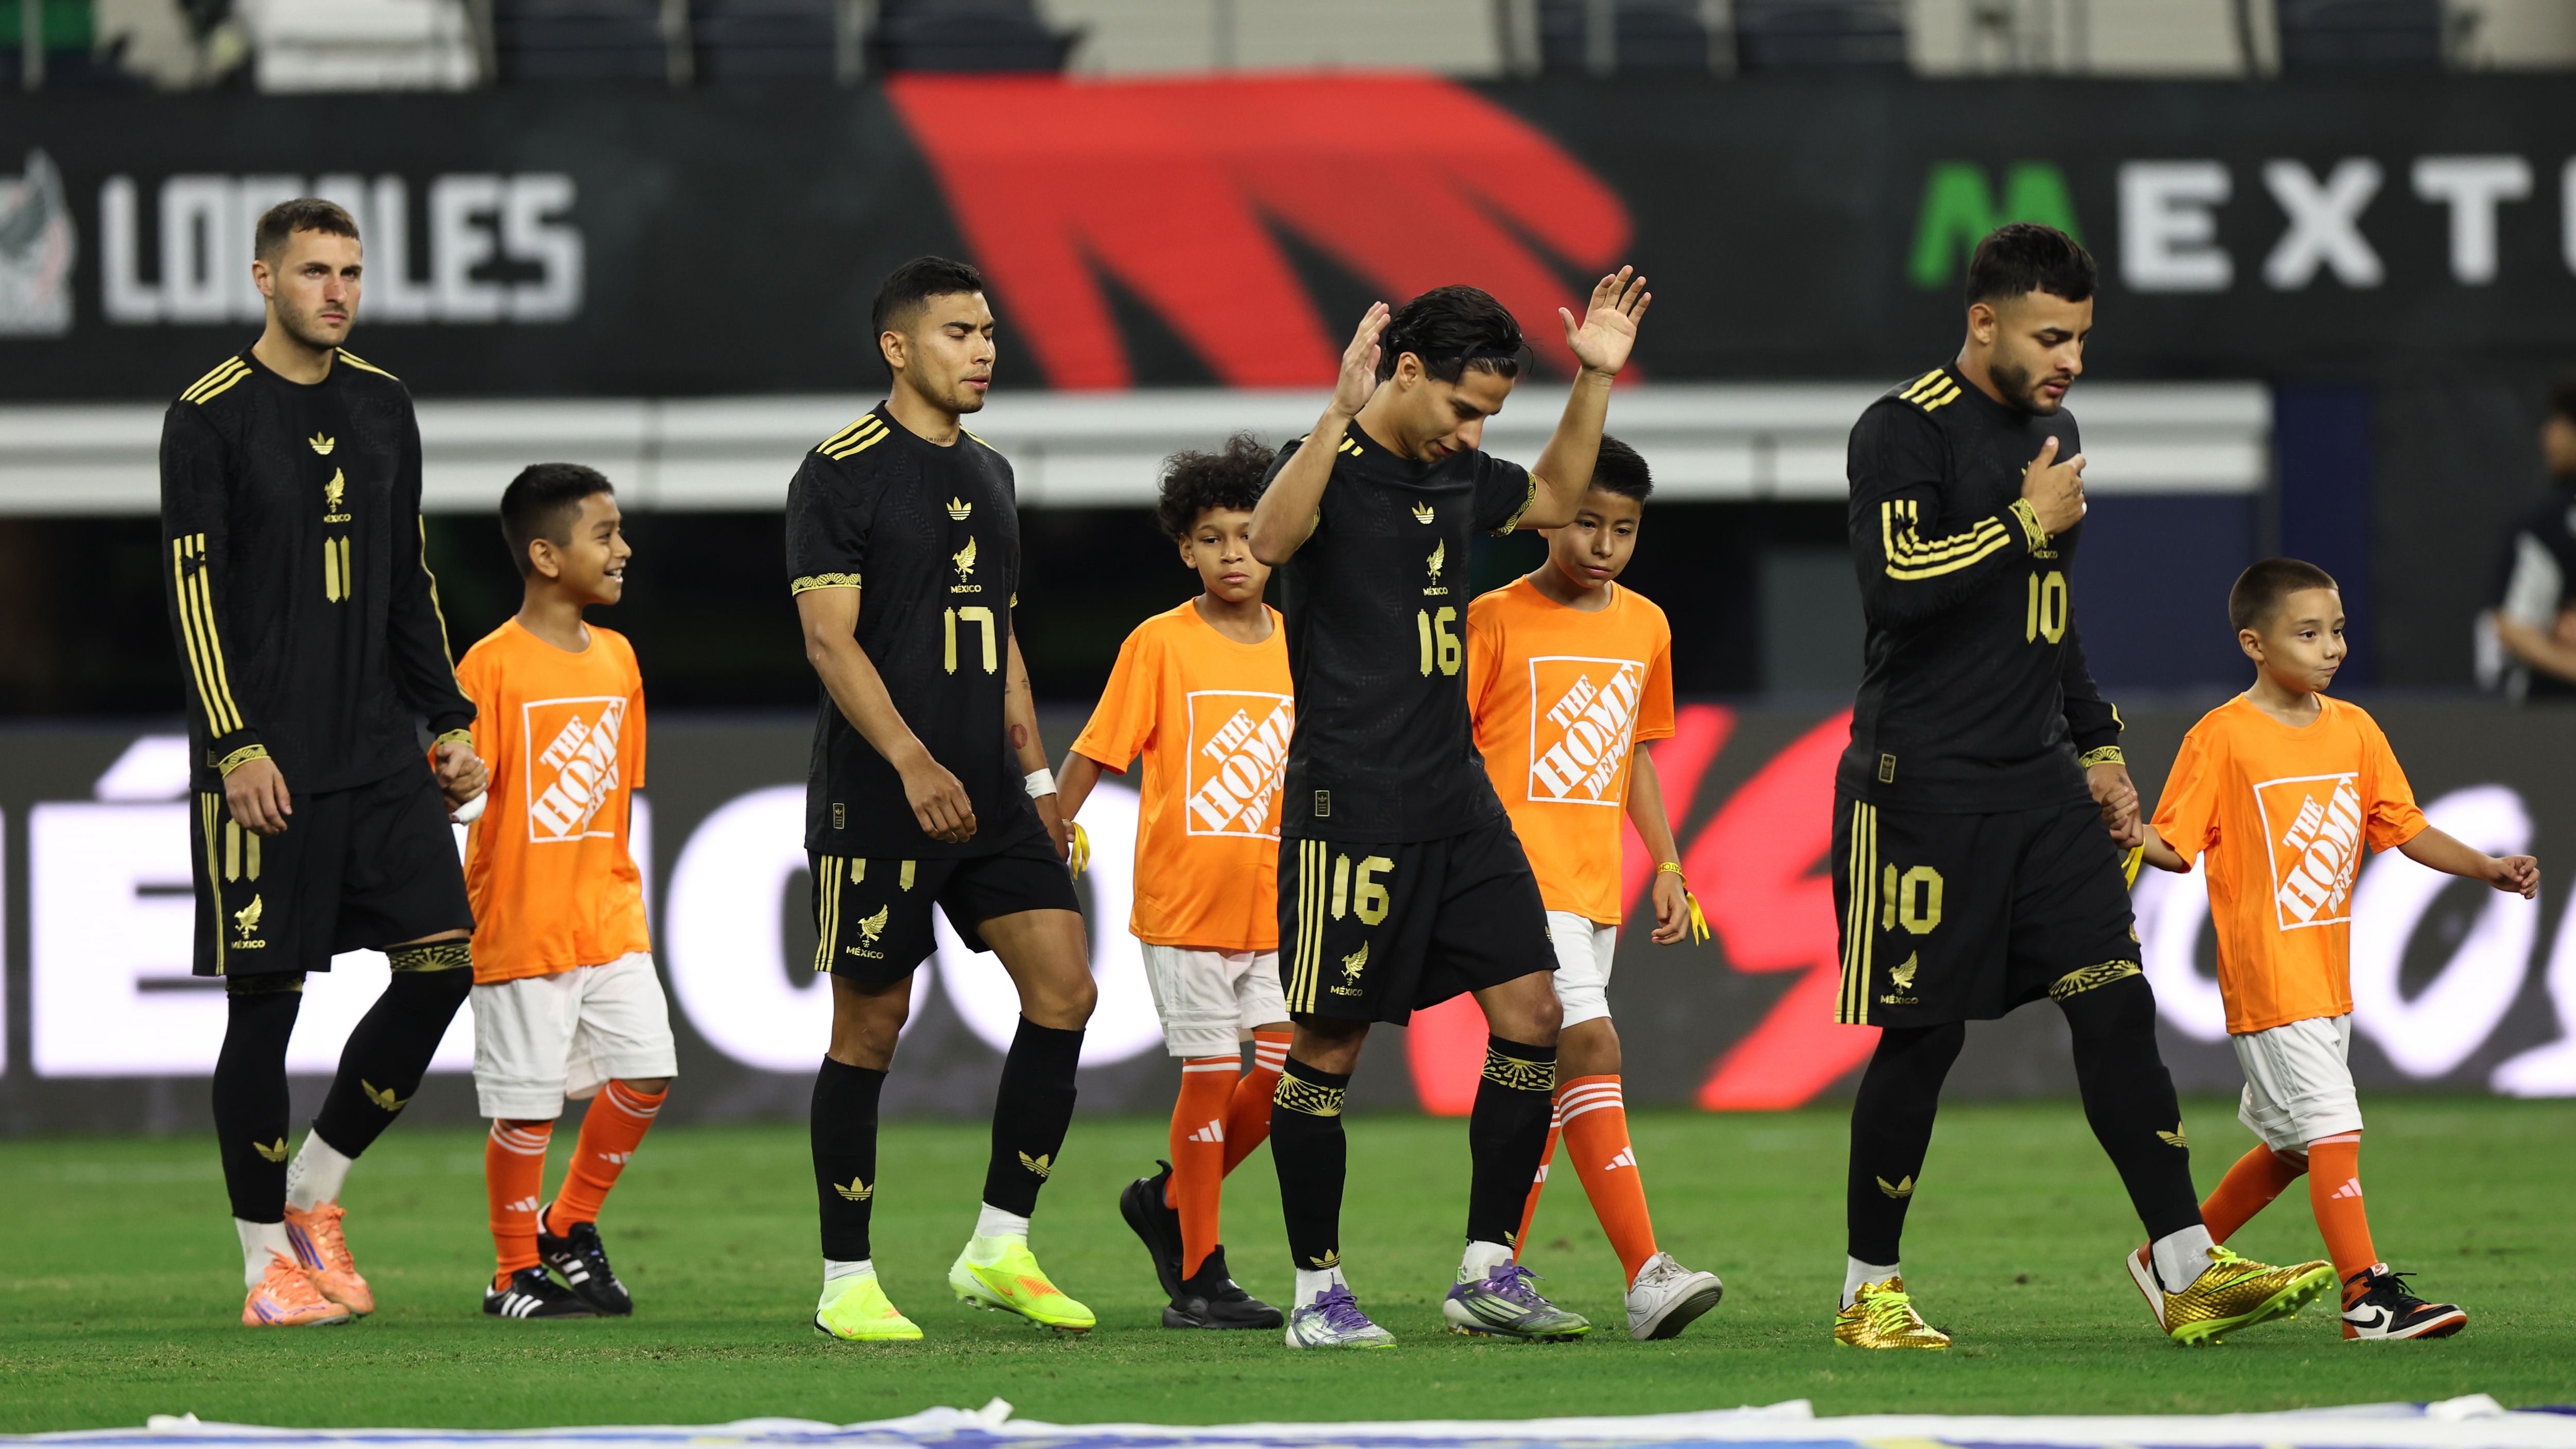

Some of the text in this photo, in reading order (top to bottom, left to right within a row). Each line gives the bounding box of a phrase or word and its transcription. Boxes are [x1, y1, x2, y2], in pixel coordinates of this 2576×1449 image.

[1909, 155, 2576, 290] MEXT
[325, 535, 351, 603] 11
[950, 584, 982, 593] MÉXICO
[1423, 586, 1448, 596] MÉXICO
[2026, 570, 2067, 644] 10
[944, 606, 997, 675] 17
[1417, 606, 1462, 677] 16
[1533, 663, 1641, 798] HOME
[1546, 674, 1598, 730] THE
[538, 714, 591, 772] THE
[1201, 708, 1256, 764] THE
[2281, 793, 2325, 853] THE
[1331, 853, 1395, 926] 16
[1882, 862, 1943, 934] 10
[231, 937, 266, 949] MÉXICO
[846, 946, 884, 959] MÉXICO
[1330, 985, 1363, 997] MÉXICO
[1880, 994, 1919, 1005] MÉXICO
